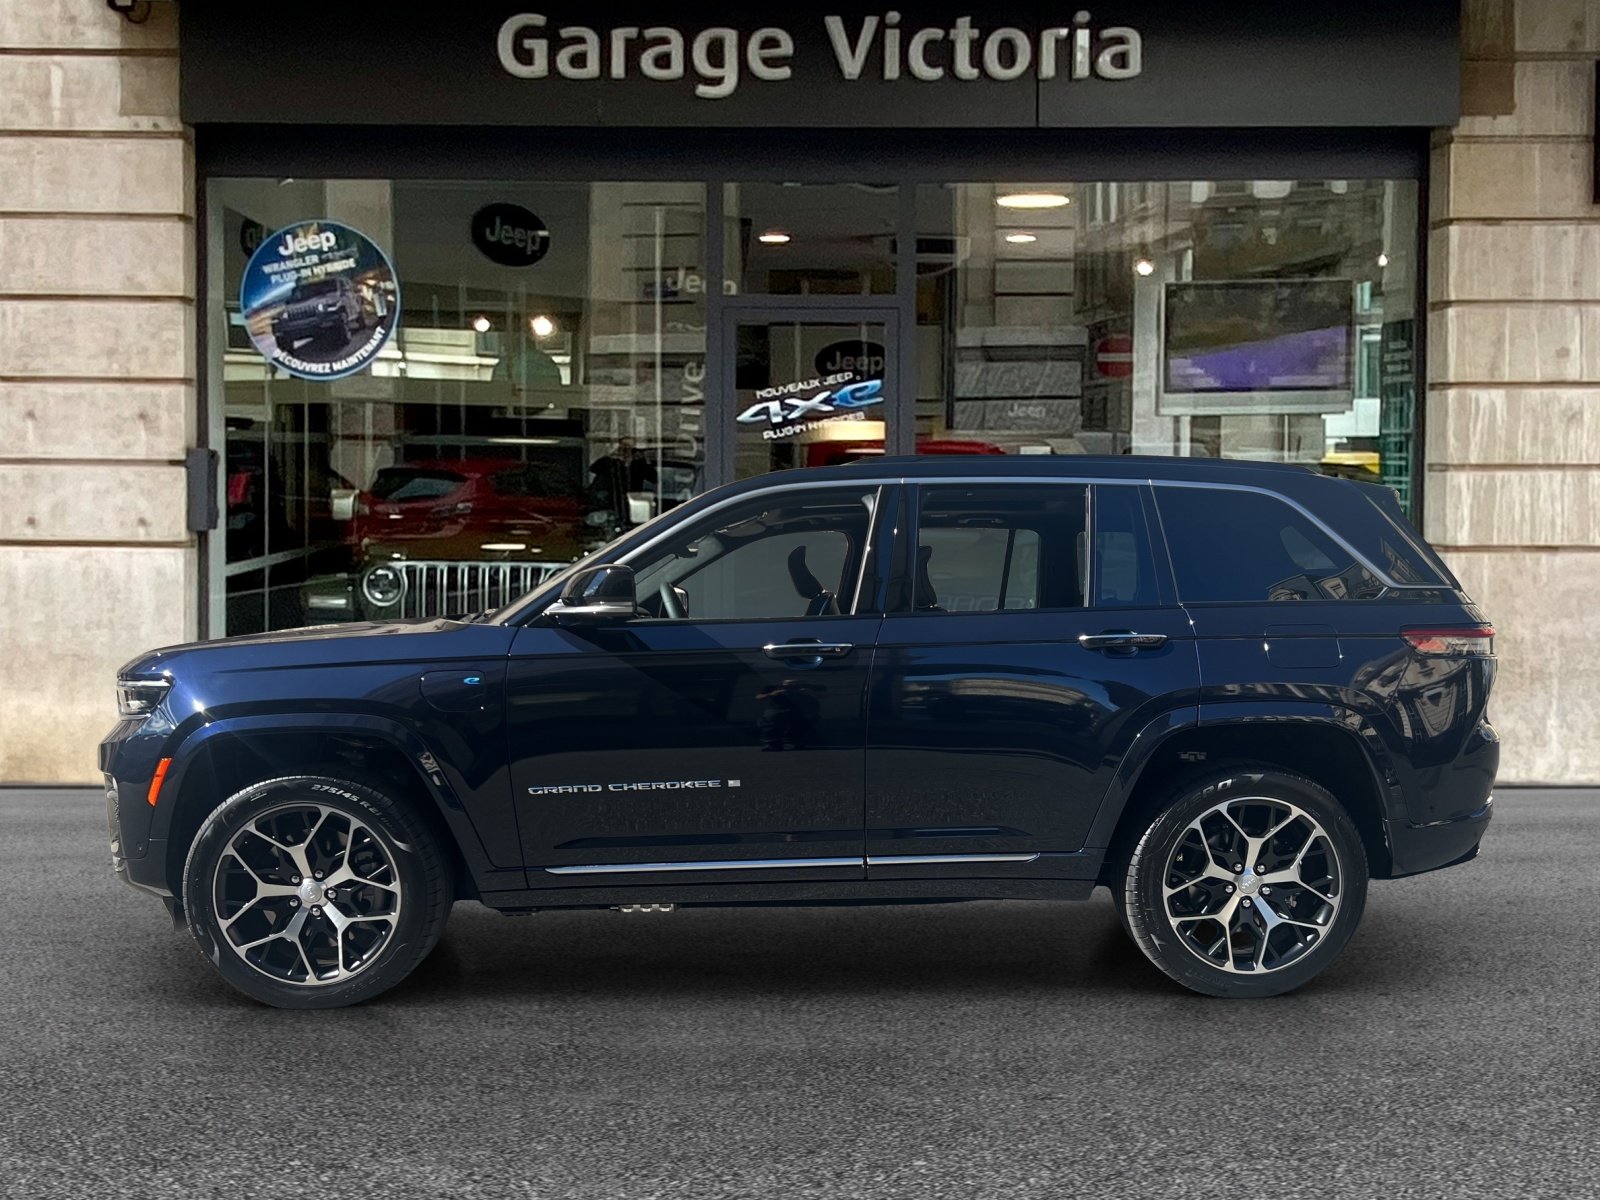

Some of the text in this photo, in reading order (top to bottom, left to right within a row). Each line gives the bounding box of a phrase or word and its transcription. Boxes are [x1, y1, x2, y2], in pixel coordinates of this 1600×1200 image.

[497, 10, 1143, 99] Garage Victoria
[278, 231, 337, 256] Jeep
[485, 216, 542, 255] Jeep
[262, 254, 320, 274] WRANGLER
[332, 326, 386, 371] MAINTENANT
[826, 350, 884, 375] Jeep
[756, 371, 853, 399] NOUVEAUX JEEP
[311, 784, 360, 802] 275/45
[528, 780, 721, 795] GRAND CHEROKEE
